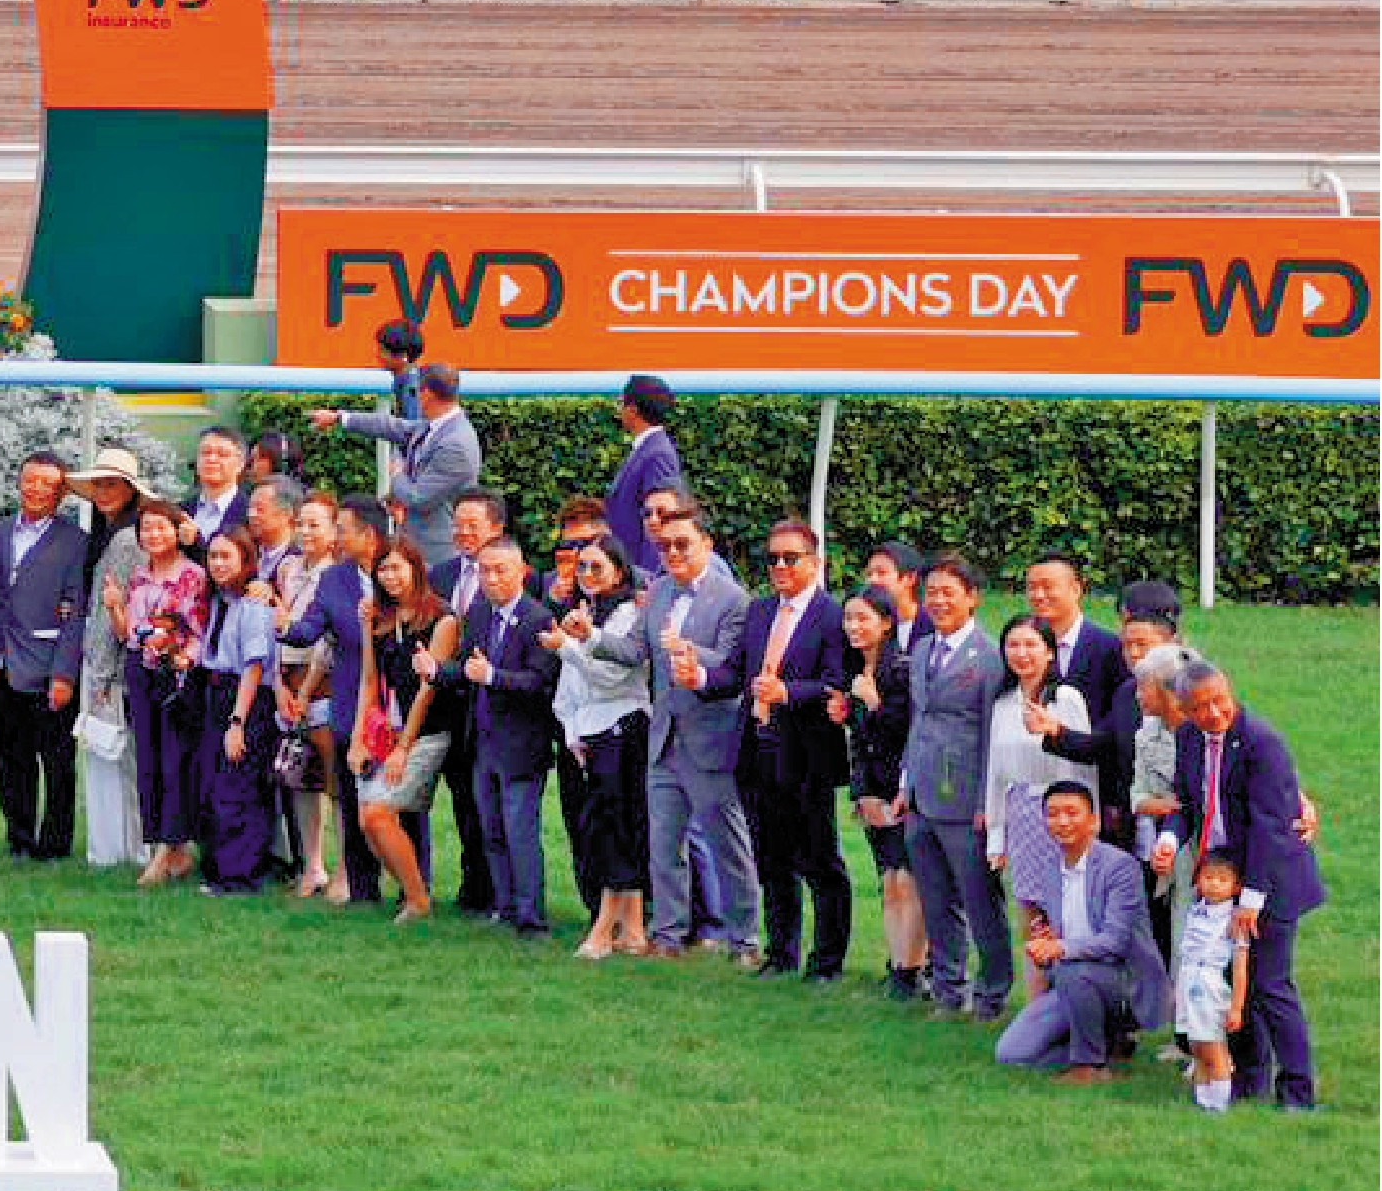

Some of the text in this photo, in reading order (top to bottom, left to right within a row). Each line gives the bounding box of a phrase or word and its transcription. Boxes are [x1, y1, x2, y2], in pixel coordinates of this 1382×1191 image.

[326, 249, 1372, 339] FWD CHAMPIONS DAY FWD
